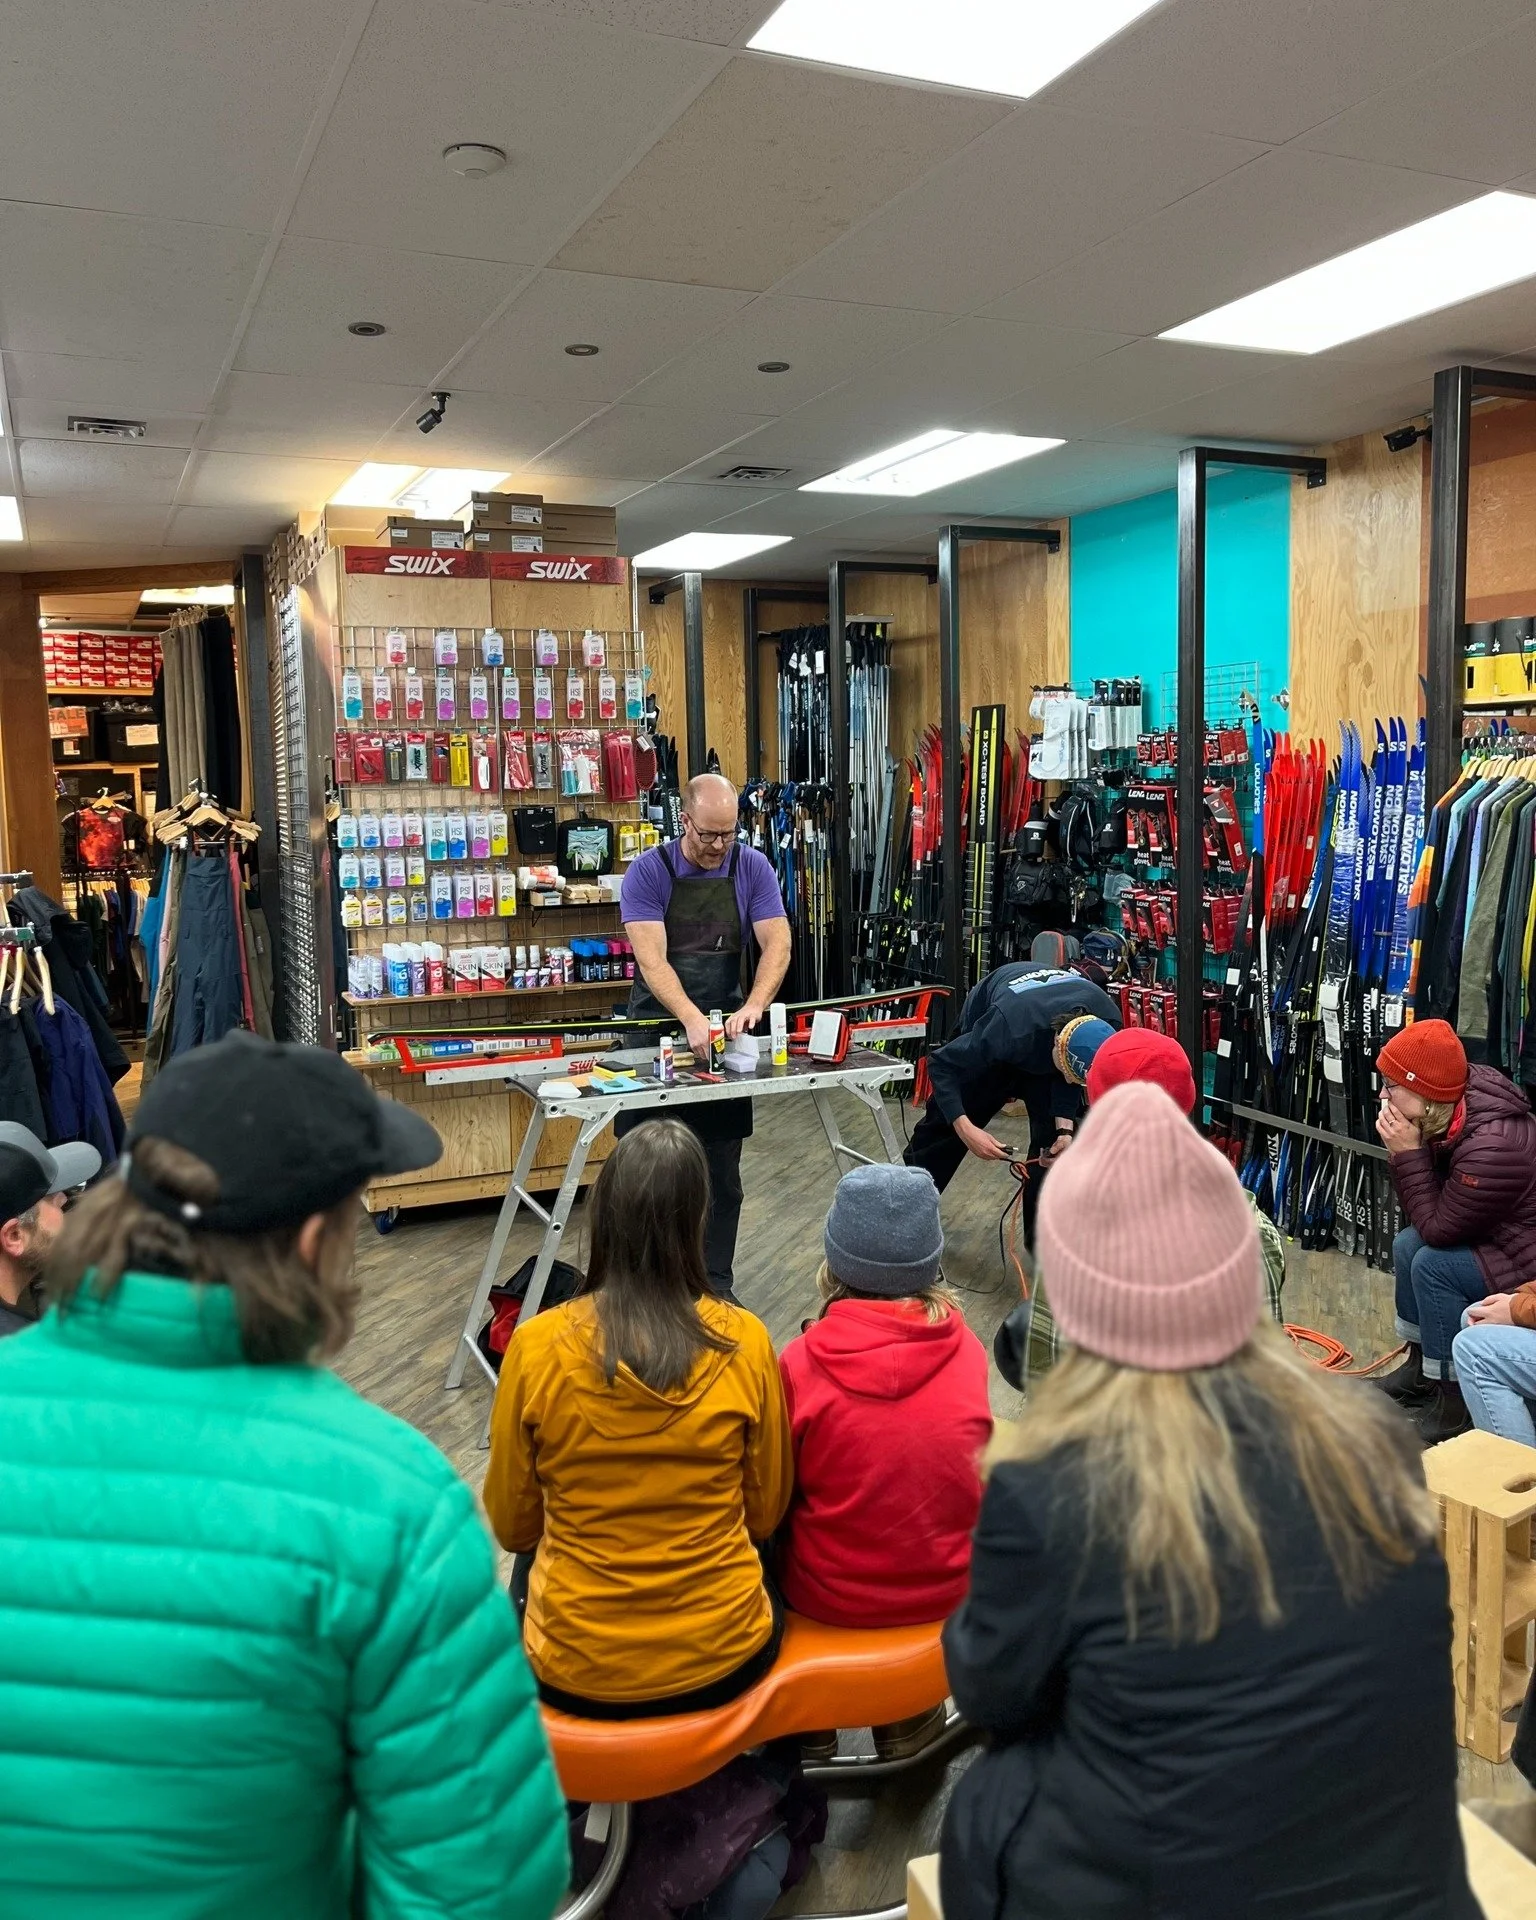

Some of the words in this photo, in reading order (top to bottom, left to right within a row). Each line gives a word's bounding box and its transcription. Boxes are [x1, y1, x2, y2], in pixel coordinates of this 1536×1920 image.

[980, 741, 988, 786] XC-TEST
[1145, 792, 1165, 800] LENZ
[1397, 813, 1415, 895] SALOMON
[1354, 838, 1364, 900] SALOMON
[457, 963, 476, 971] SKIN
[484, 962, 503, 970] SKIN
